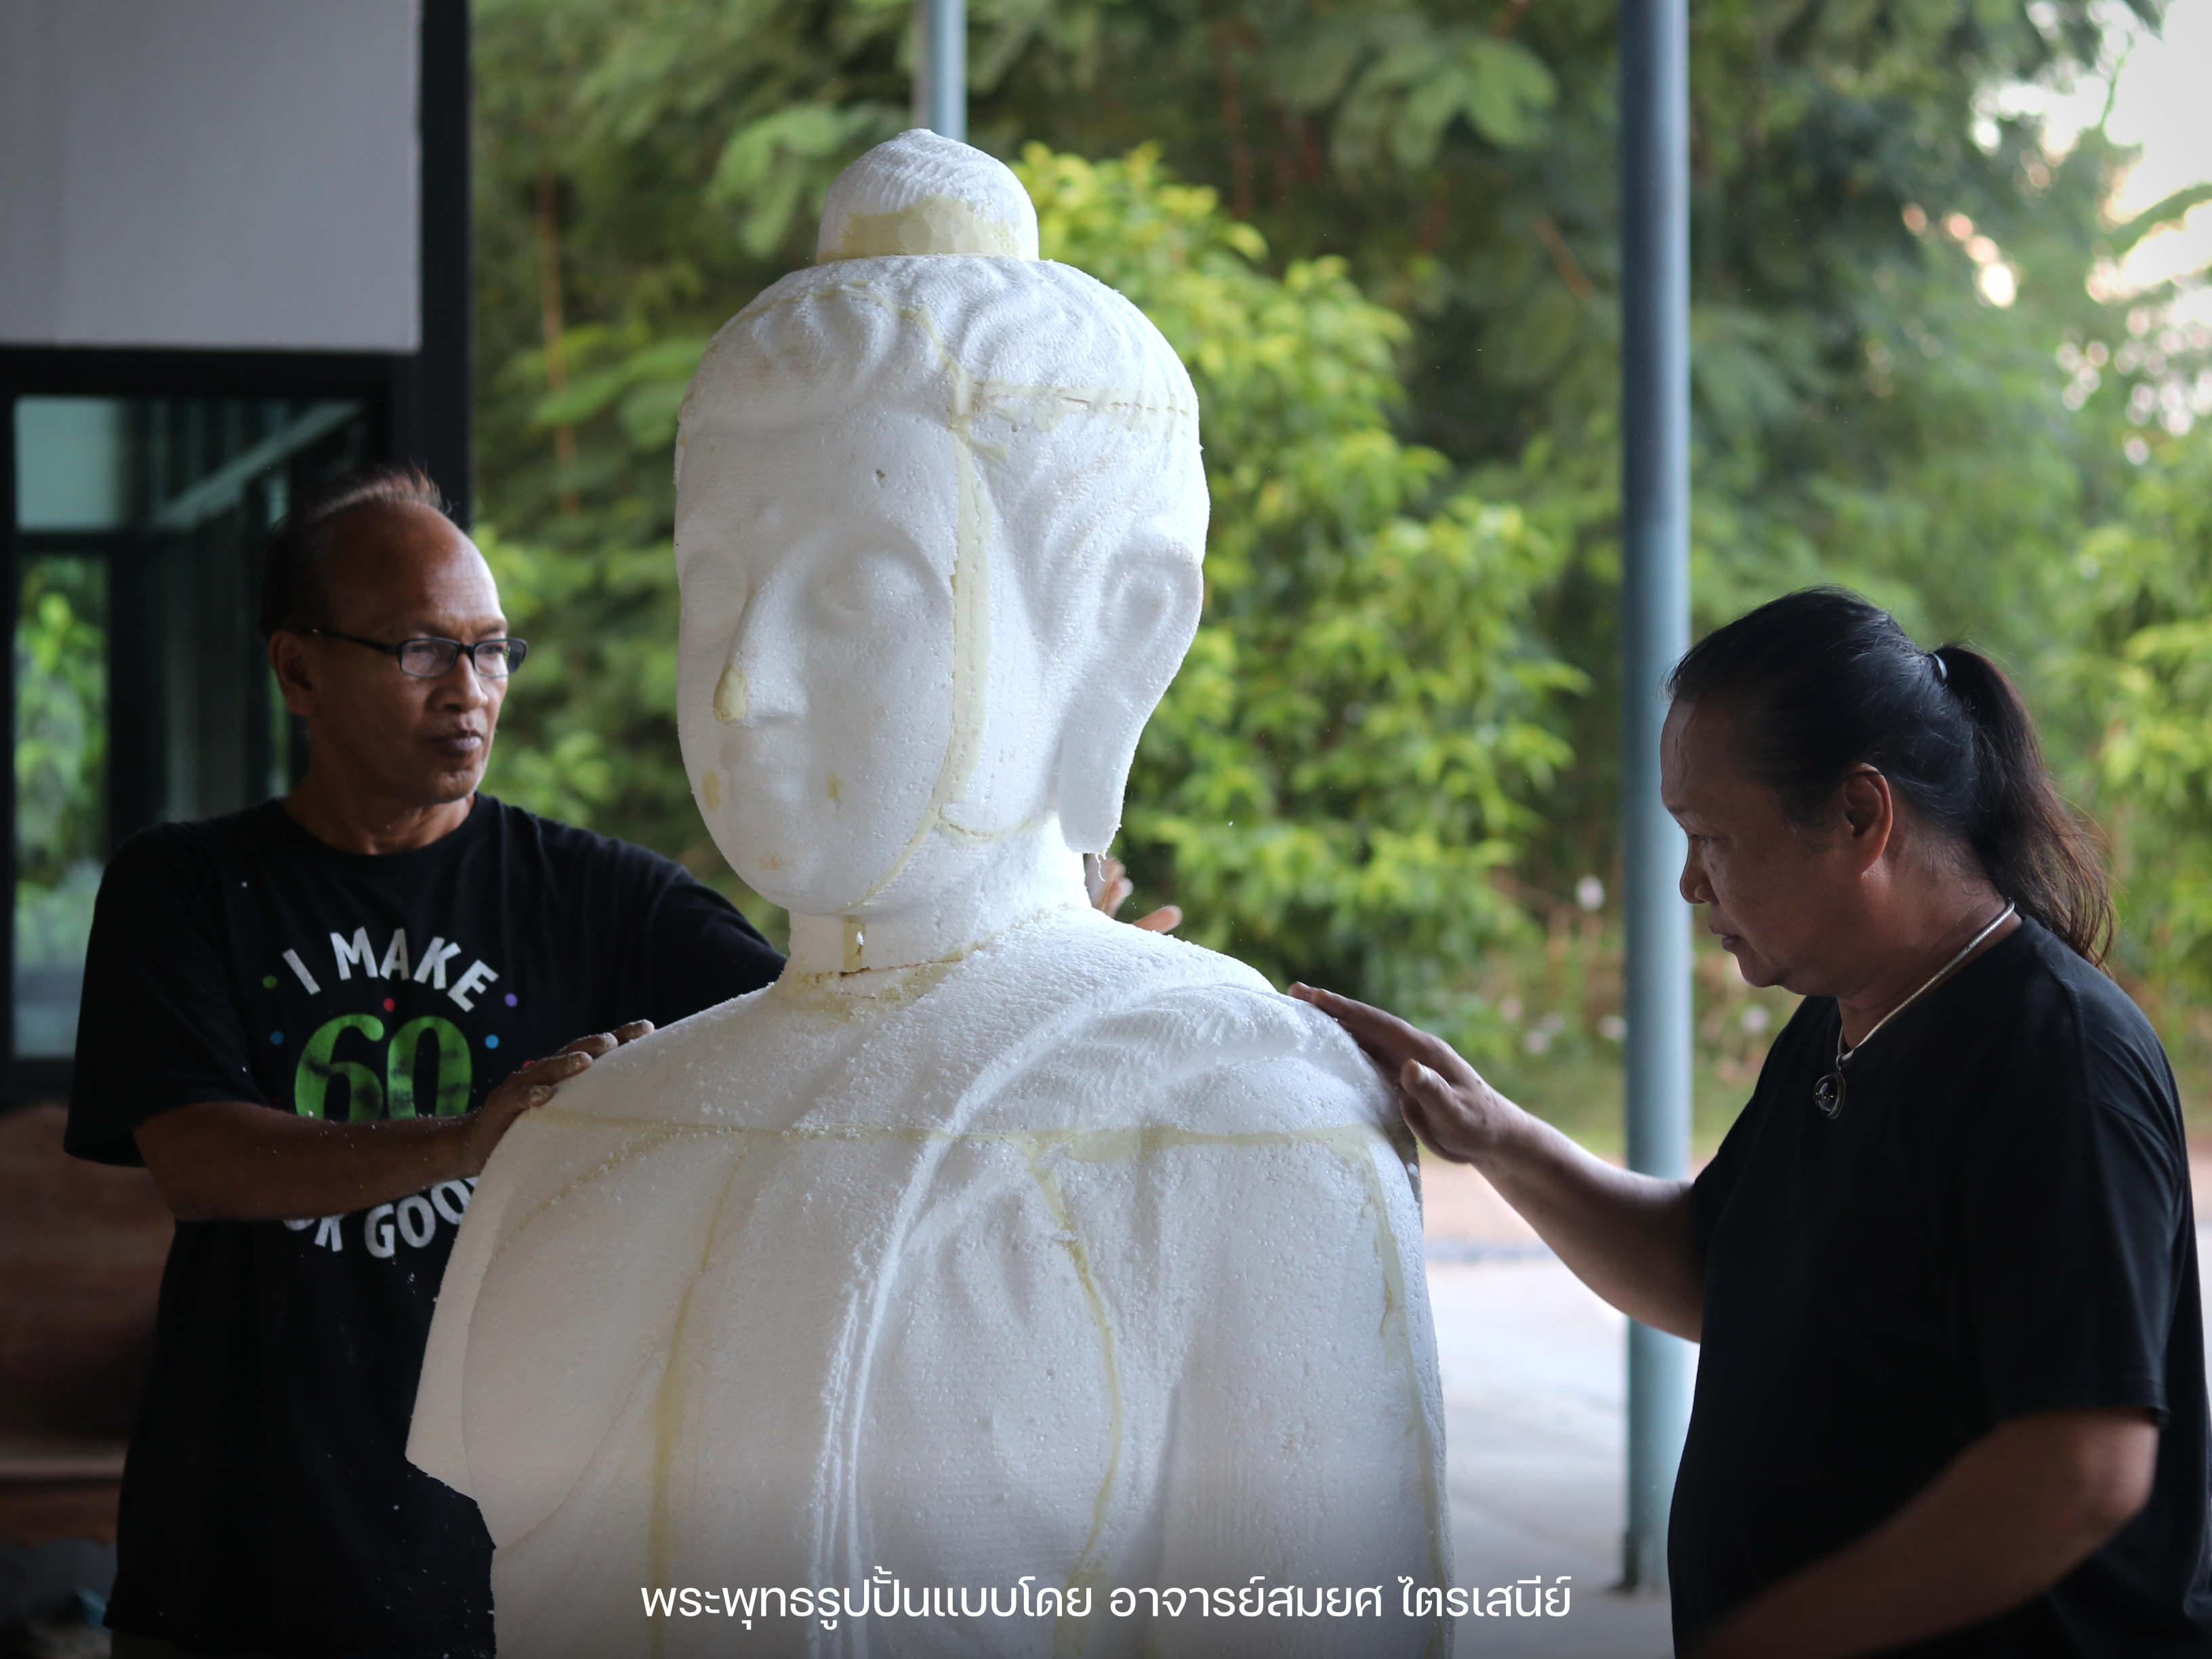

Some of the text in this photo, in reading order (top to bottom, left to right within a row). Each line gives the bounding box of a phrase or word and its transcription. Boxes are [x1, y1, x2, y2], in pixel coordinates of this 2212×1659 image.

[282, 926, 499, 1012] I MAKE
[294, 1013, 472, 1122] 60
[364, 1176, 480, 1258] GOO
